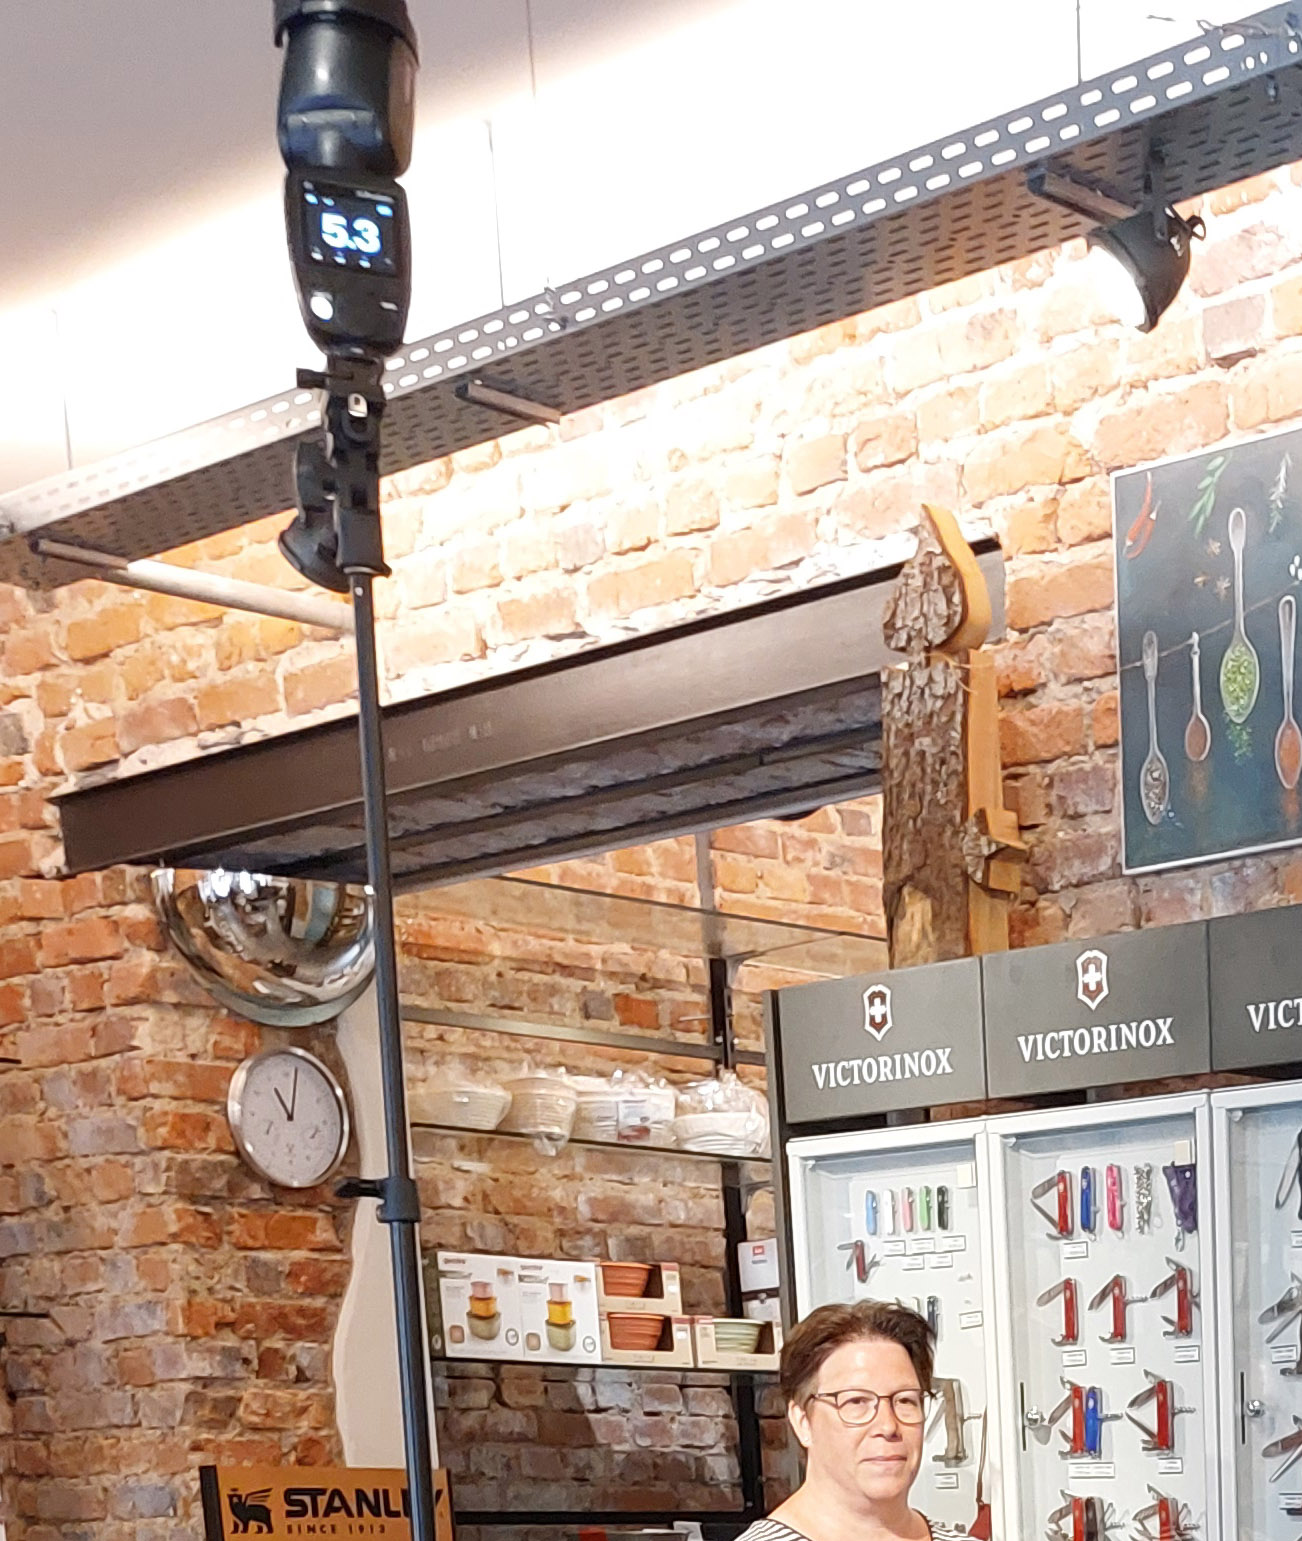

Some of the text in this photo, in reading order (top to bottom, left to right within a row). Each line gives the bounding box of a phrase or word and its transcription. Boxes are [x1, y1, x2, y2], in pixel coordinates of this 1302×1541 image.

[321, 212, 381, 253] 5.3
[1017, 1017, 1175, 1063] VICTORINOX
[812, 1048, 953, 1089] VICTORINOX
[283, 1488, 443, 1518] STANL
[287, 1524, 385, 1534] SINCE 1913
